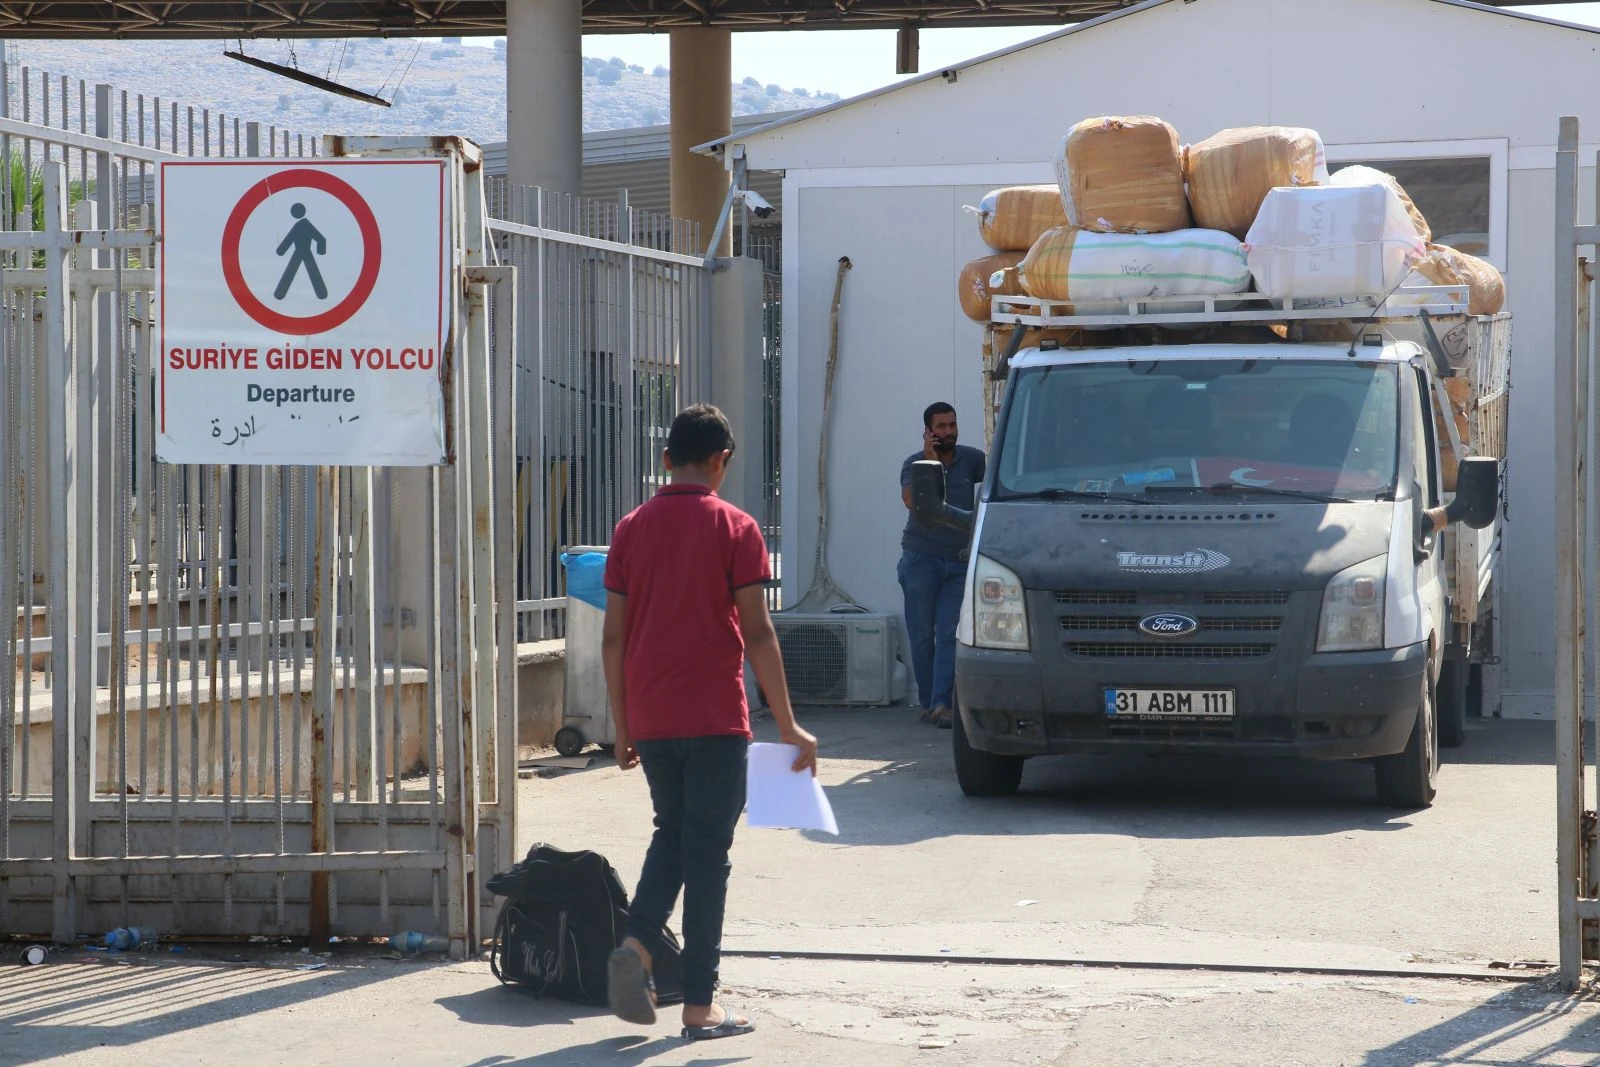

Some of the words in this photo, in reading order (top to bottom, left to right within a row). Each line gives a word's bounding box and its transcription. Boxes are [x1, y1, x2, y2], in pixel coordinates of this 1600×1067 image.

[169, 342, 258, 370] SURİYE
[265, 342, 342, 370] GİDEN
[349, 348, 434, 370] YOLCU
[246, 383, 355, 407] Departure
[1117, 551, 1204, 567] Transit
[1152, 617, 1183, 631] Ford
[1116, 692, 1138, 712] 31
[1148, 692, 1192, 713] ABM
[1202, 692, 1227, 713] 111
